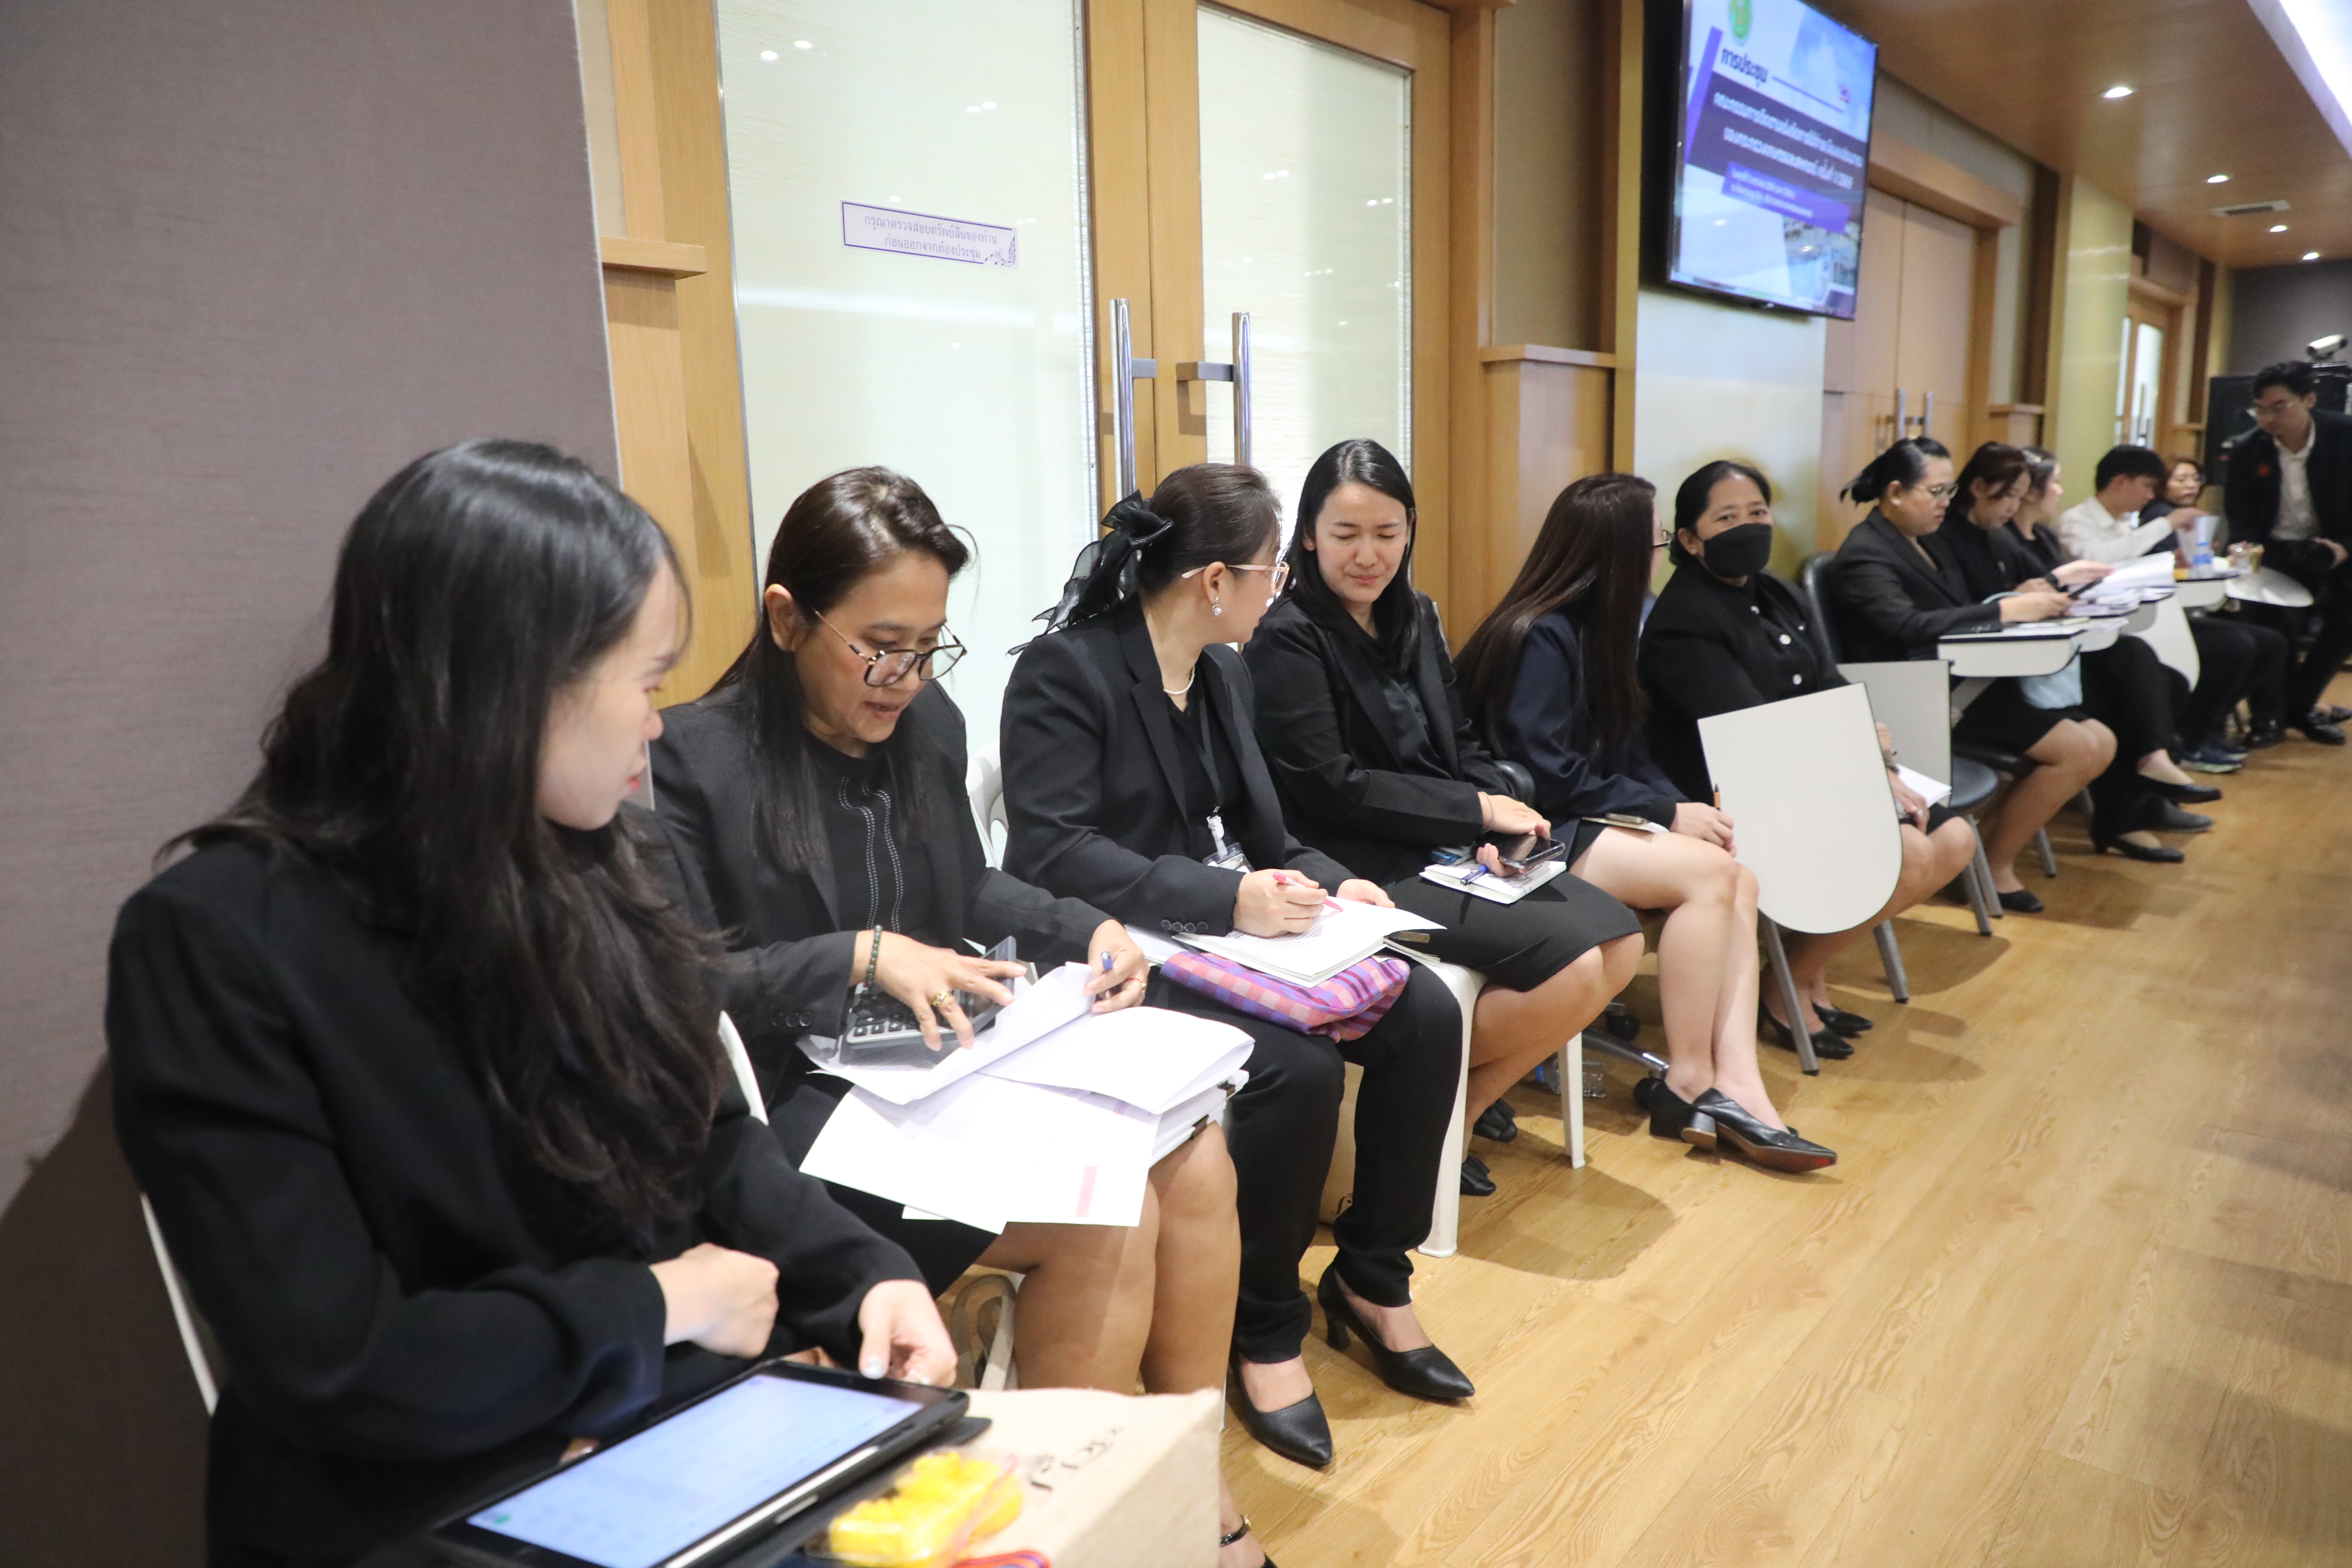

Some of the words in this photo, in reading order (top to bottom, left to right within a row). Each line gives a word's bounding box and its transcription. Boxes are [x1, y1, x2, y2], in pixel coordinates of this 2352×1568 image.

[1721, 48, 1768, 87] การประชุม
[885, 233, 981, 260] ก่อนออกจากห้องประชุม
